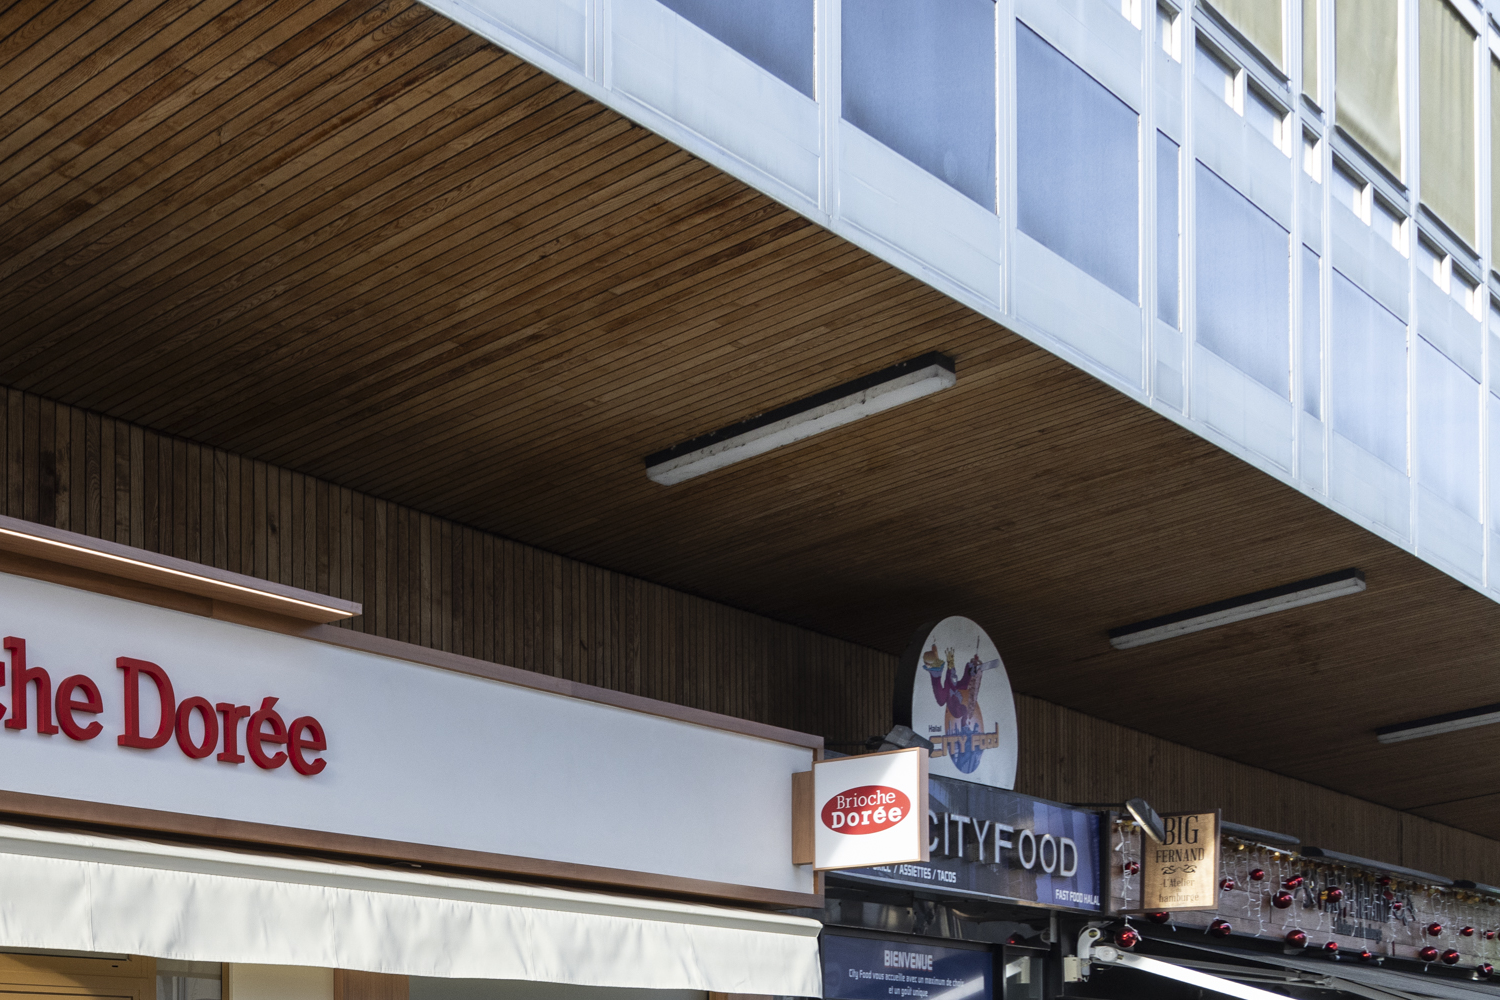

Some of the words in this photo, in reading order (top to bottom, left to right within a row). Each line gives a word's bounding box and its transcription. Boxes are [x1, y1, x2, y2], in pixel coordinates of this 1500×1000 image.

[116, 656, 327, 776] Dorée
[929, 734, 968, 759] CITY
[836, 789, 896, 810] Brioche
[831, 807, 903, 829] Dorée
[1162, 815, 1200, 846] BIG
[1155, 847, 1205, 863] FERNAND
[899, 864, 931, 879] ASSIETTES
[937, 869, 957, 883] TACOS
[1055, 889, 1070, 901] FAST
[1069, 891, 1083, 903] FOOD
[1084, 893, 1101, 906] HALAL
[883, 949, 934, 972] BIENVENUE
[848, 968, 859, 981] City
[859, 969, 872, 979] Food
[872, 972, 884, 981] vous
[906, 975, 917, 983] avec
[946, 977, 952, 986] de
[894, 987, 901, 995] un
